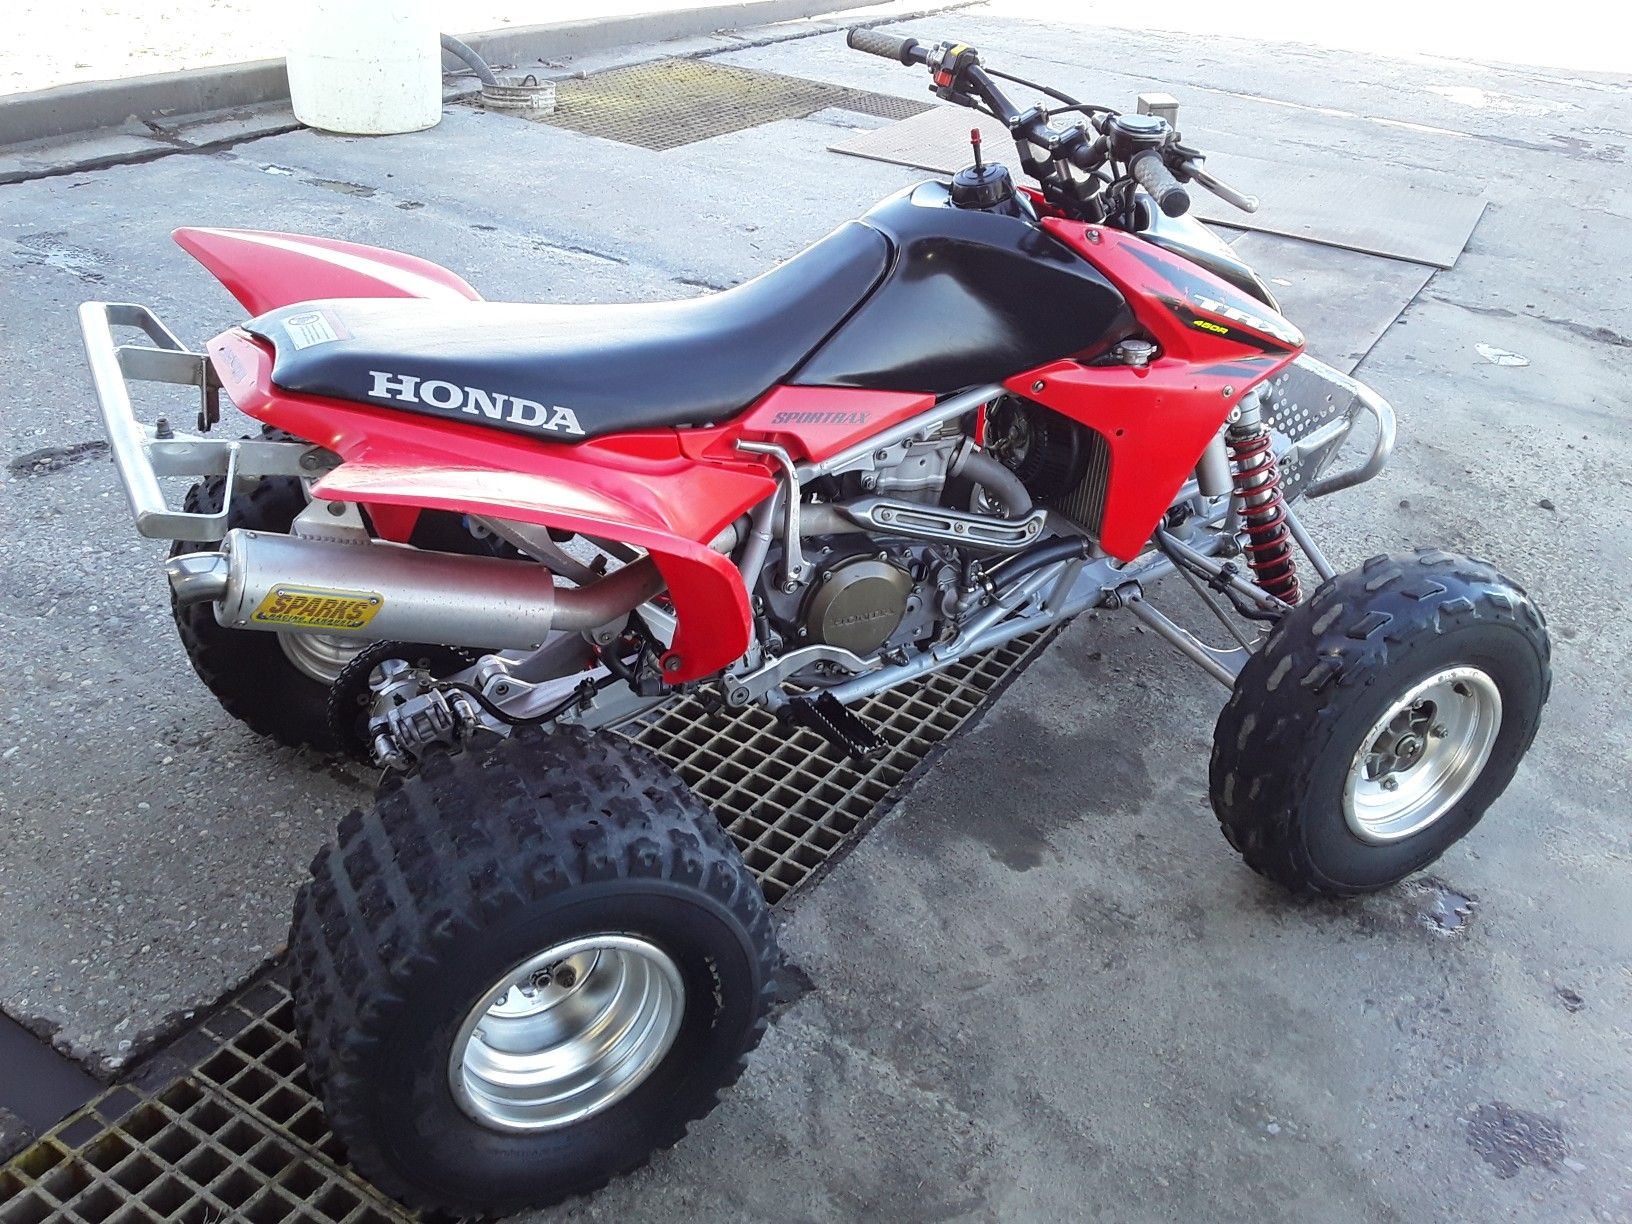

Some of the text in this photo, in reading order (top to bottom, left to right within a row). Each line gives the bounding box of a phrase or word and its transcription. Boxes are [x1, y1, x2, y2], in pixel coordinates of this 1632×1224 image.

[368, 370, 586, 435] HONDA
[771, 410, 870, 425] SPORTRAX
[268, 594, 369, 620] SPARKS
